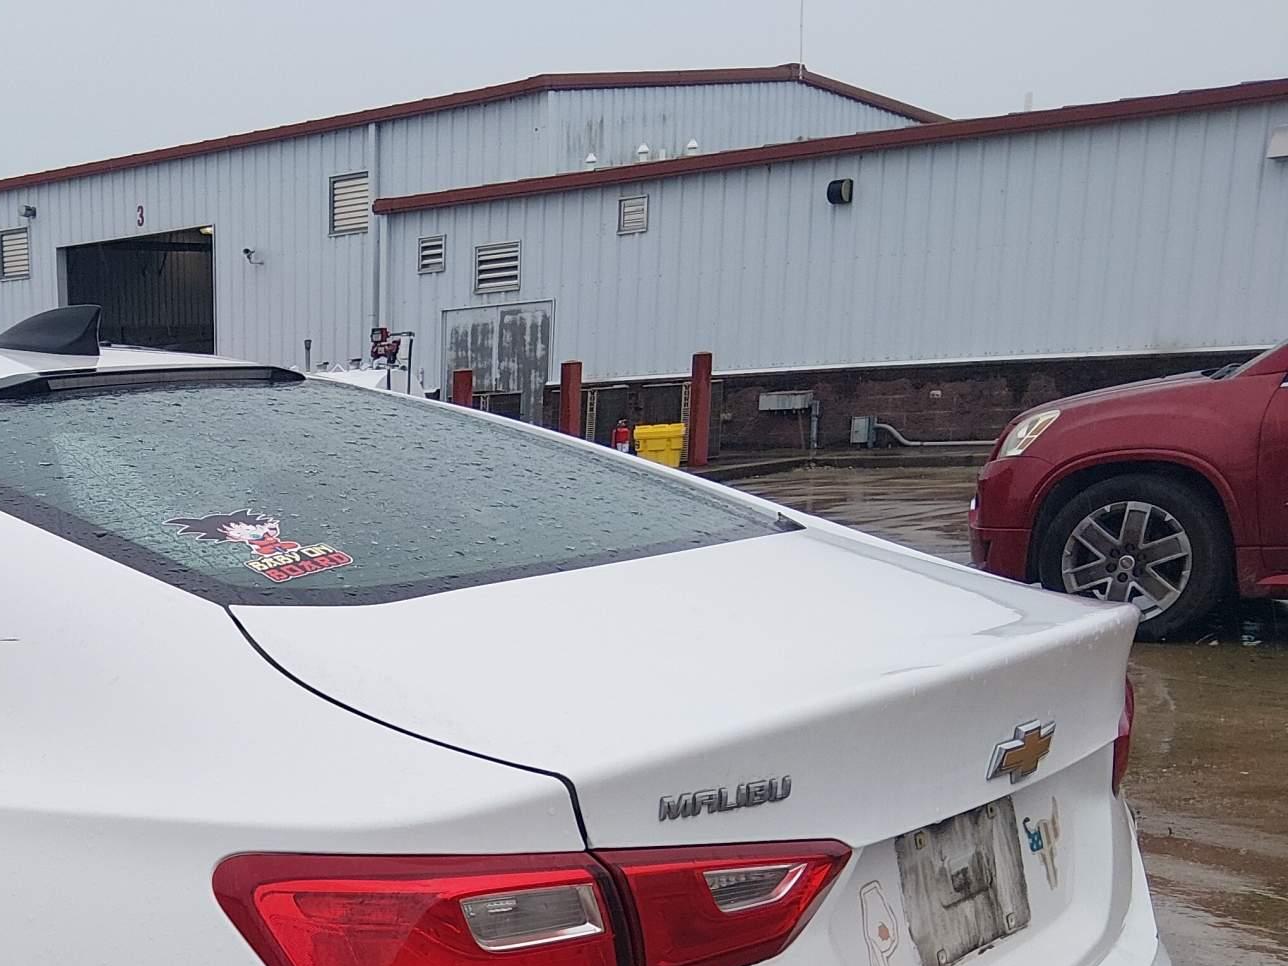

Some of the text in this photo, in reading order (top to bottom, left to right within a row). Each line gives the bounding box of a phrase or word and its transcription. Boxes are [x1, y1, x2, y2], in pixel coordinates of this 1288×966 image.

[136, 205, 145, 227] 3
[248, 543, 335, 571] BABY ON
[265, 553, 350, 580] BOARD
[658, 774, 792, 822] MALIBU
